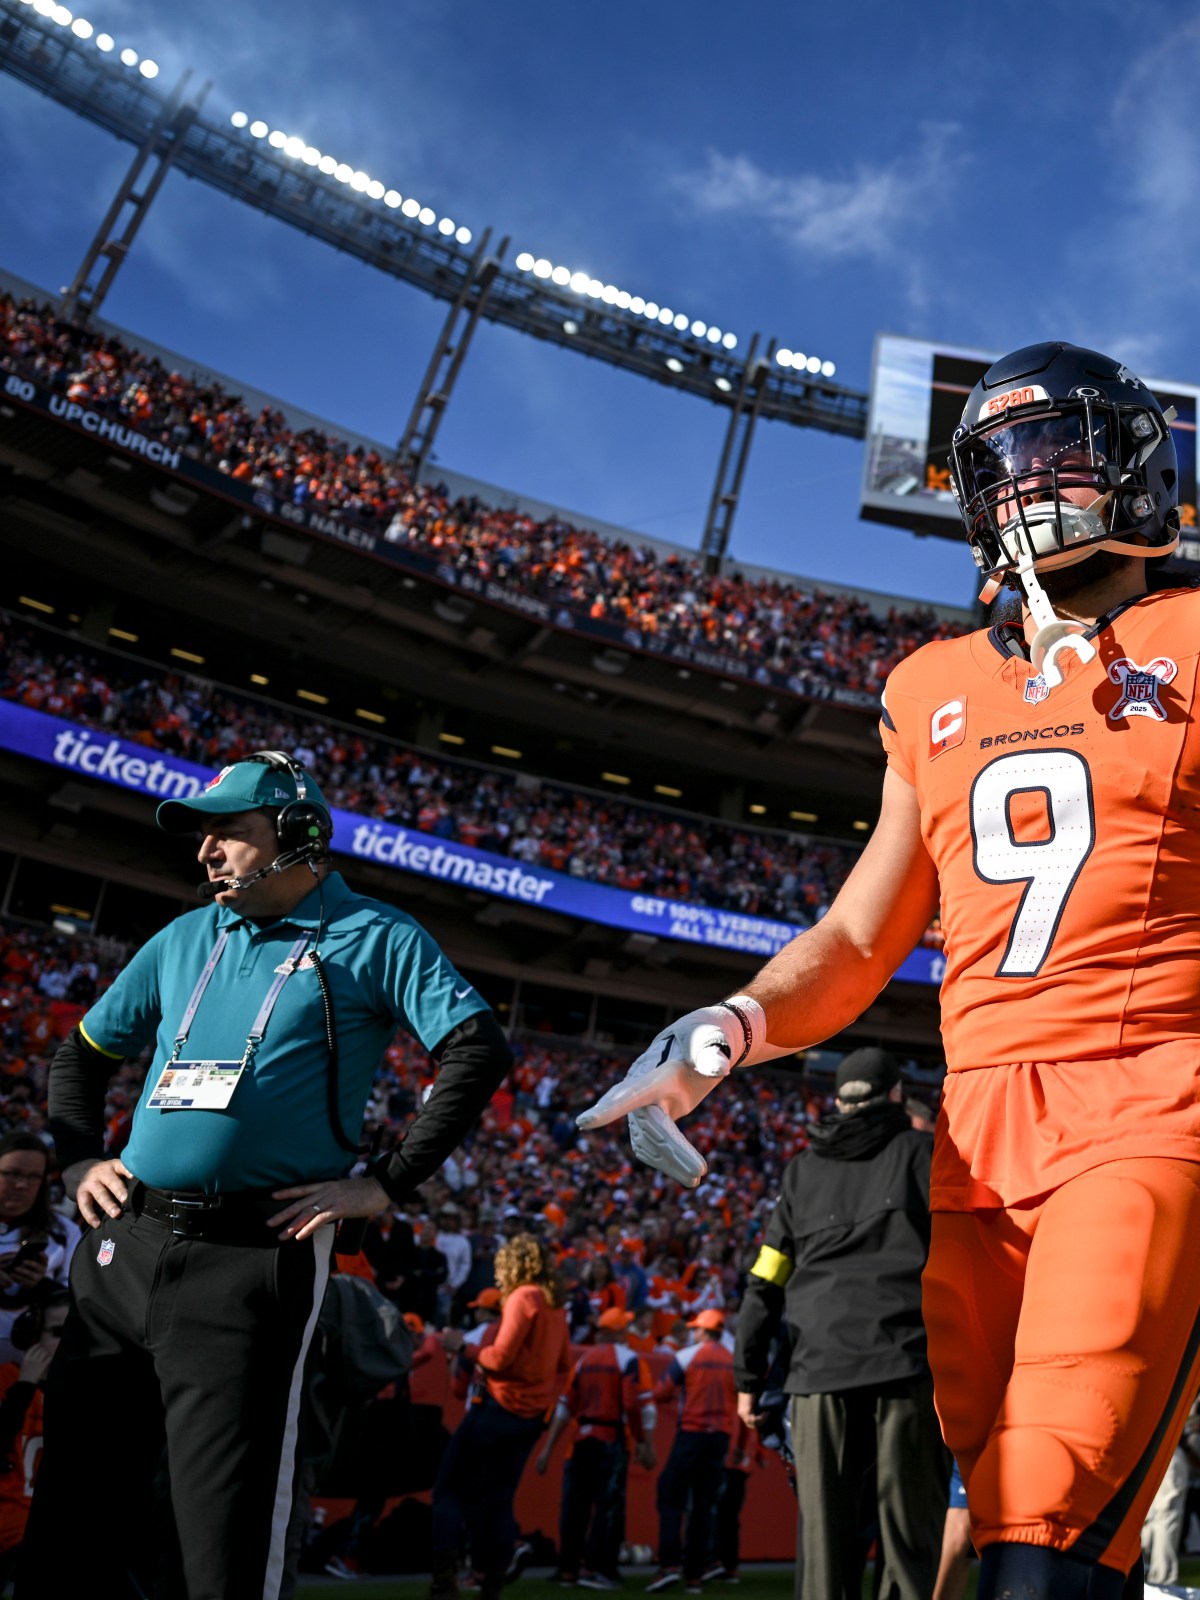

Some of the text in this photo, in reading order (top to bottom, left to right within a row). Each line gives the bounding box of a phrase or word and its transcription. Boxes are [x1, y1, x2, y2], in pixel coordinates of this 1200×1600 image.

[987, 387, 1035, 416] 5280
[4, 375, 181, 470] 80 UPCHURCH
[309, 513, 376, 550] NALEN
[1127, 684, 1152, 699] NFL
[1129, 705, 1148, 713] 2025
[931, 700, 963, 744] C
[979, 722, 1085, 749] BRONCOS
[53, 729, 206, 798] ticketm
[352, 824, 554, 902] ticketmaster
[969, 747, 1096, 977] 9
[631, 896, 667, 918] GET
[669, 903, 716, 926] 100%
[718, 913, 792, 941] VERIFIED
[669, 921, 703, 941] ALL
[705, 928, 772, 953] SEASON
